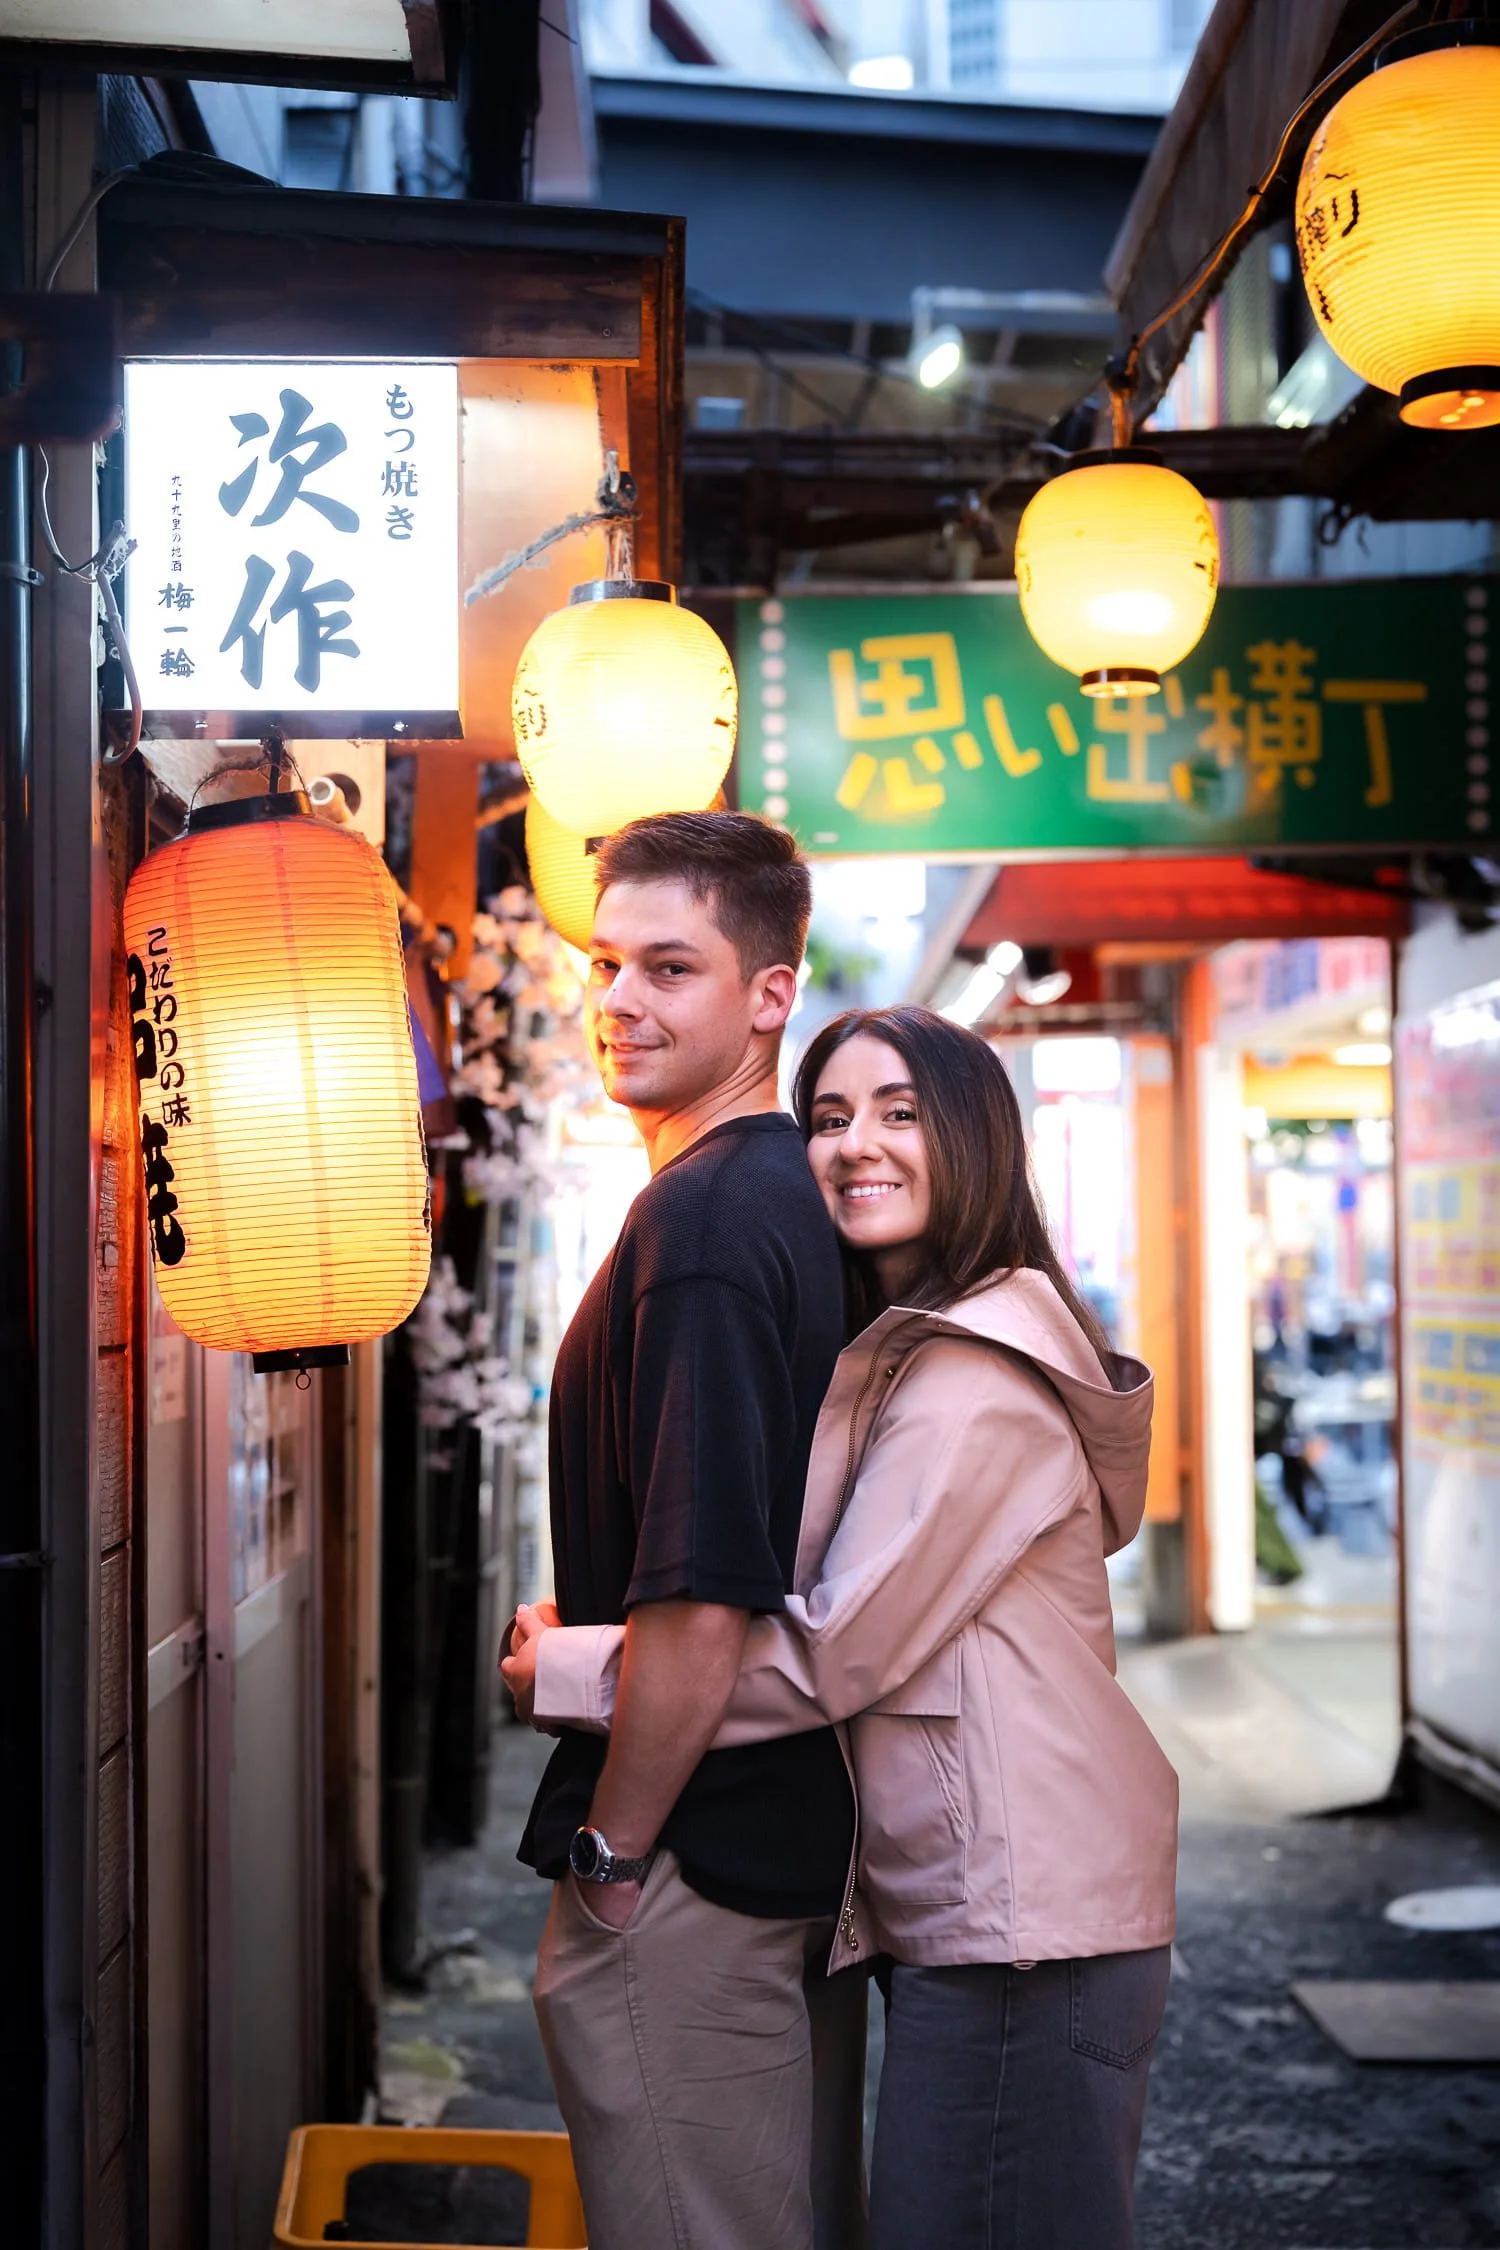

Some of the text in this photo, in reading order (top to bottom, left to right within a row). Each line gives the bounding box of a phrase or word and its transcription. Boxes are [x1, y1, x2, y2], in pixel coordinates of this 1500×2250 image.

[218, 388, 360, 693] 次作
[380, 383, 419, 541] もつ焼き
[158, 582, 195, 678] 梅一輪
[828, 632, 1428, 814] 思い出横丁
[147, 926, 192, 1128] こだわりの味
